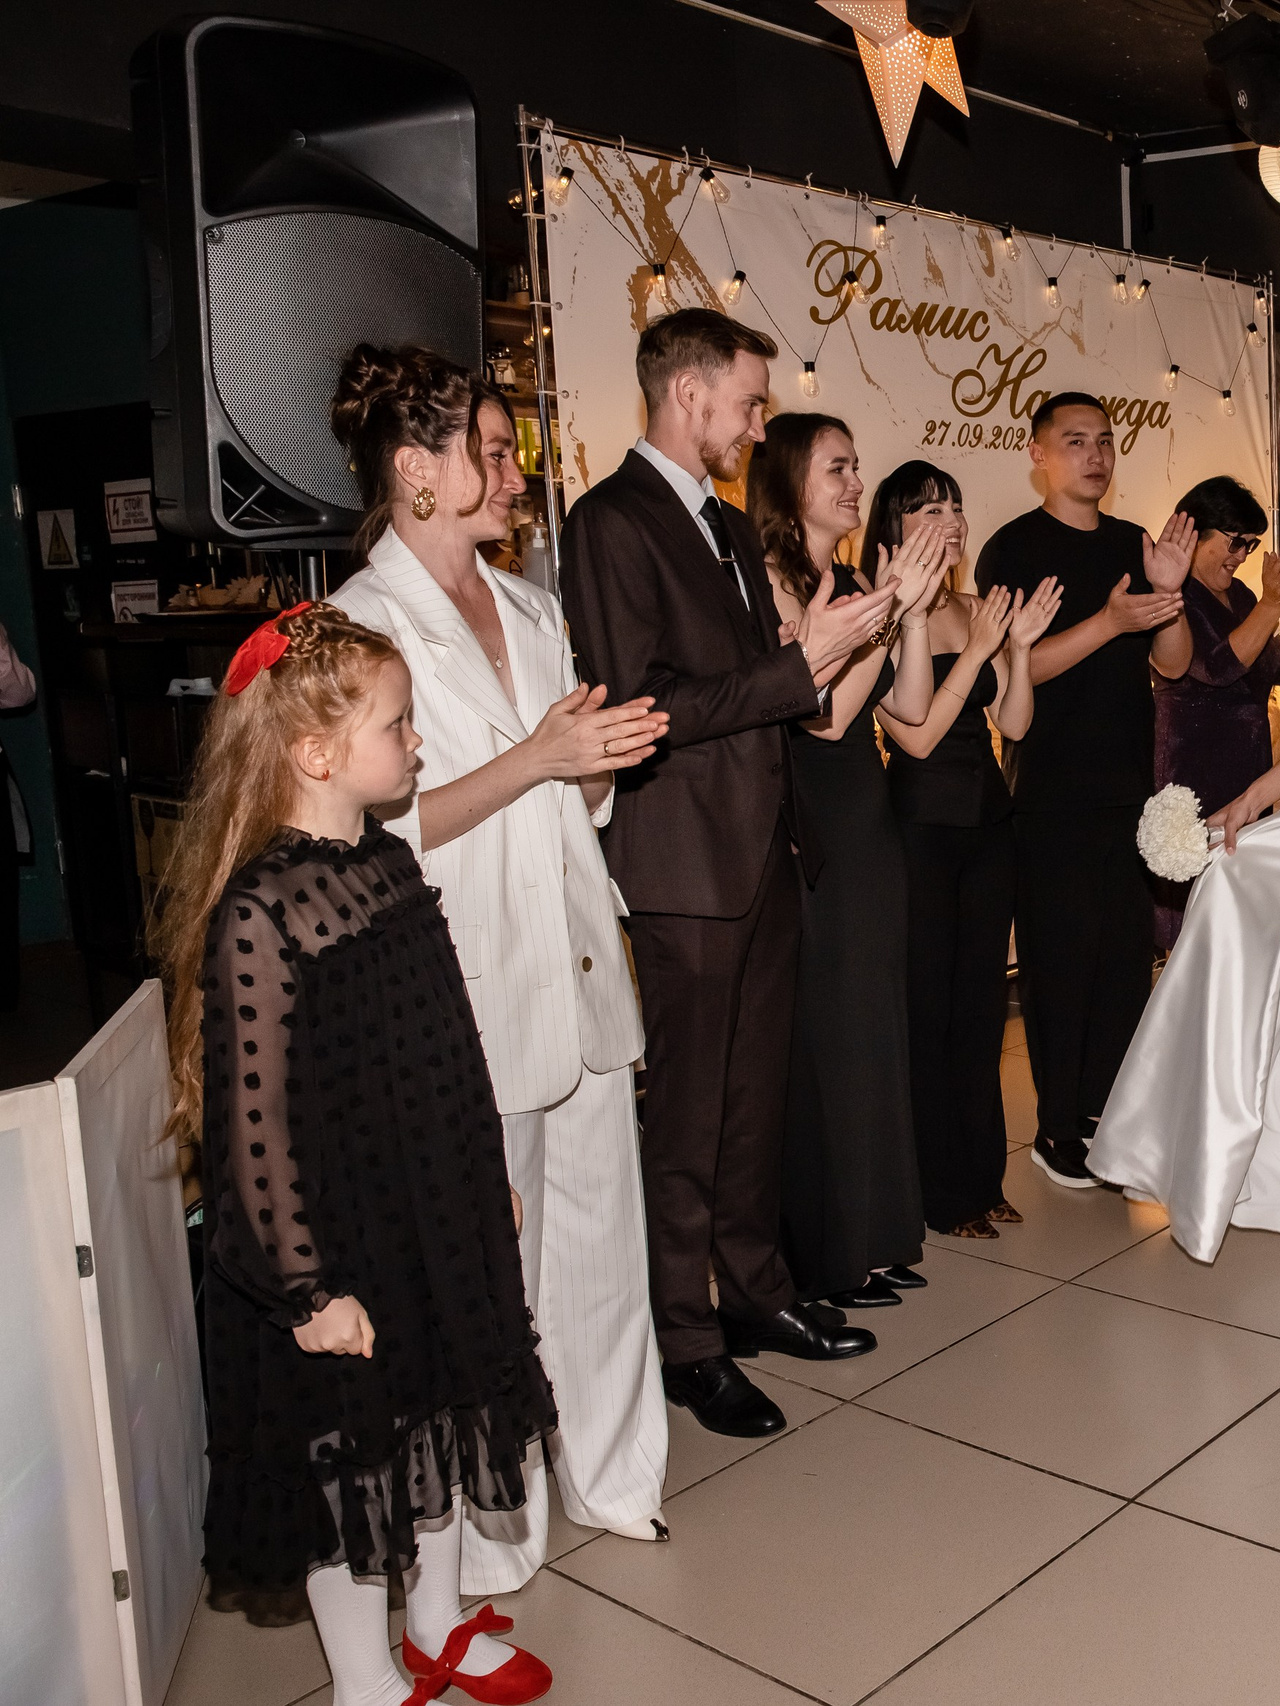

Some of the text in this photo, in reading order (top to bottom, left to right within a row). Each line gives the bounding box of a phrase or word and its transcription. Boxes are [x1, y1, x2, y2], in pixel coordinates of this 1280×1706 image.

[806, 239, 991, 343] Рамис
[921, 420, 1033, 452] 27.09.202
[951, 343, 1172, 456] Нажда
